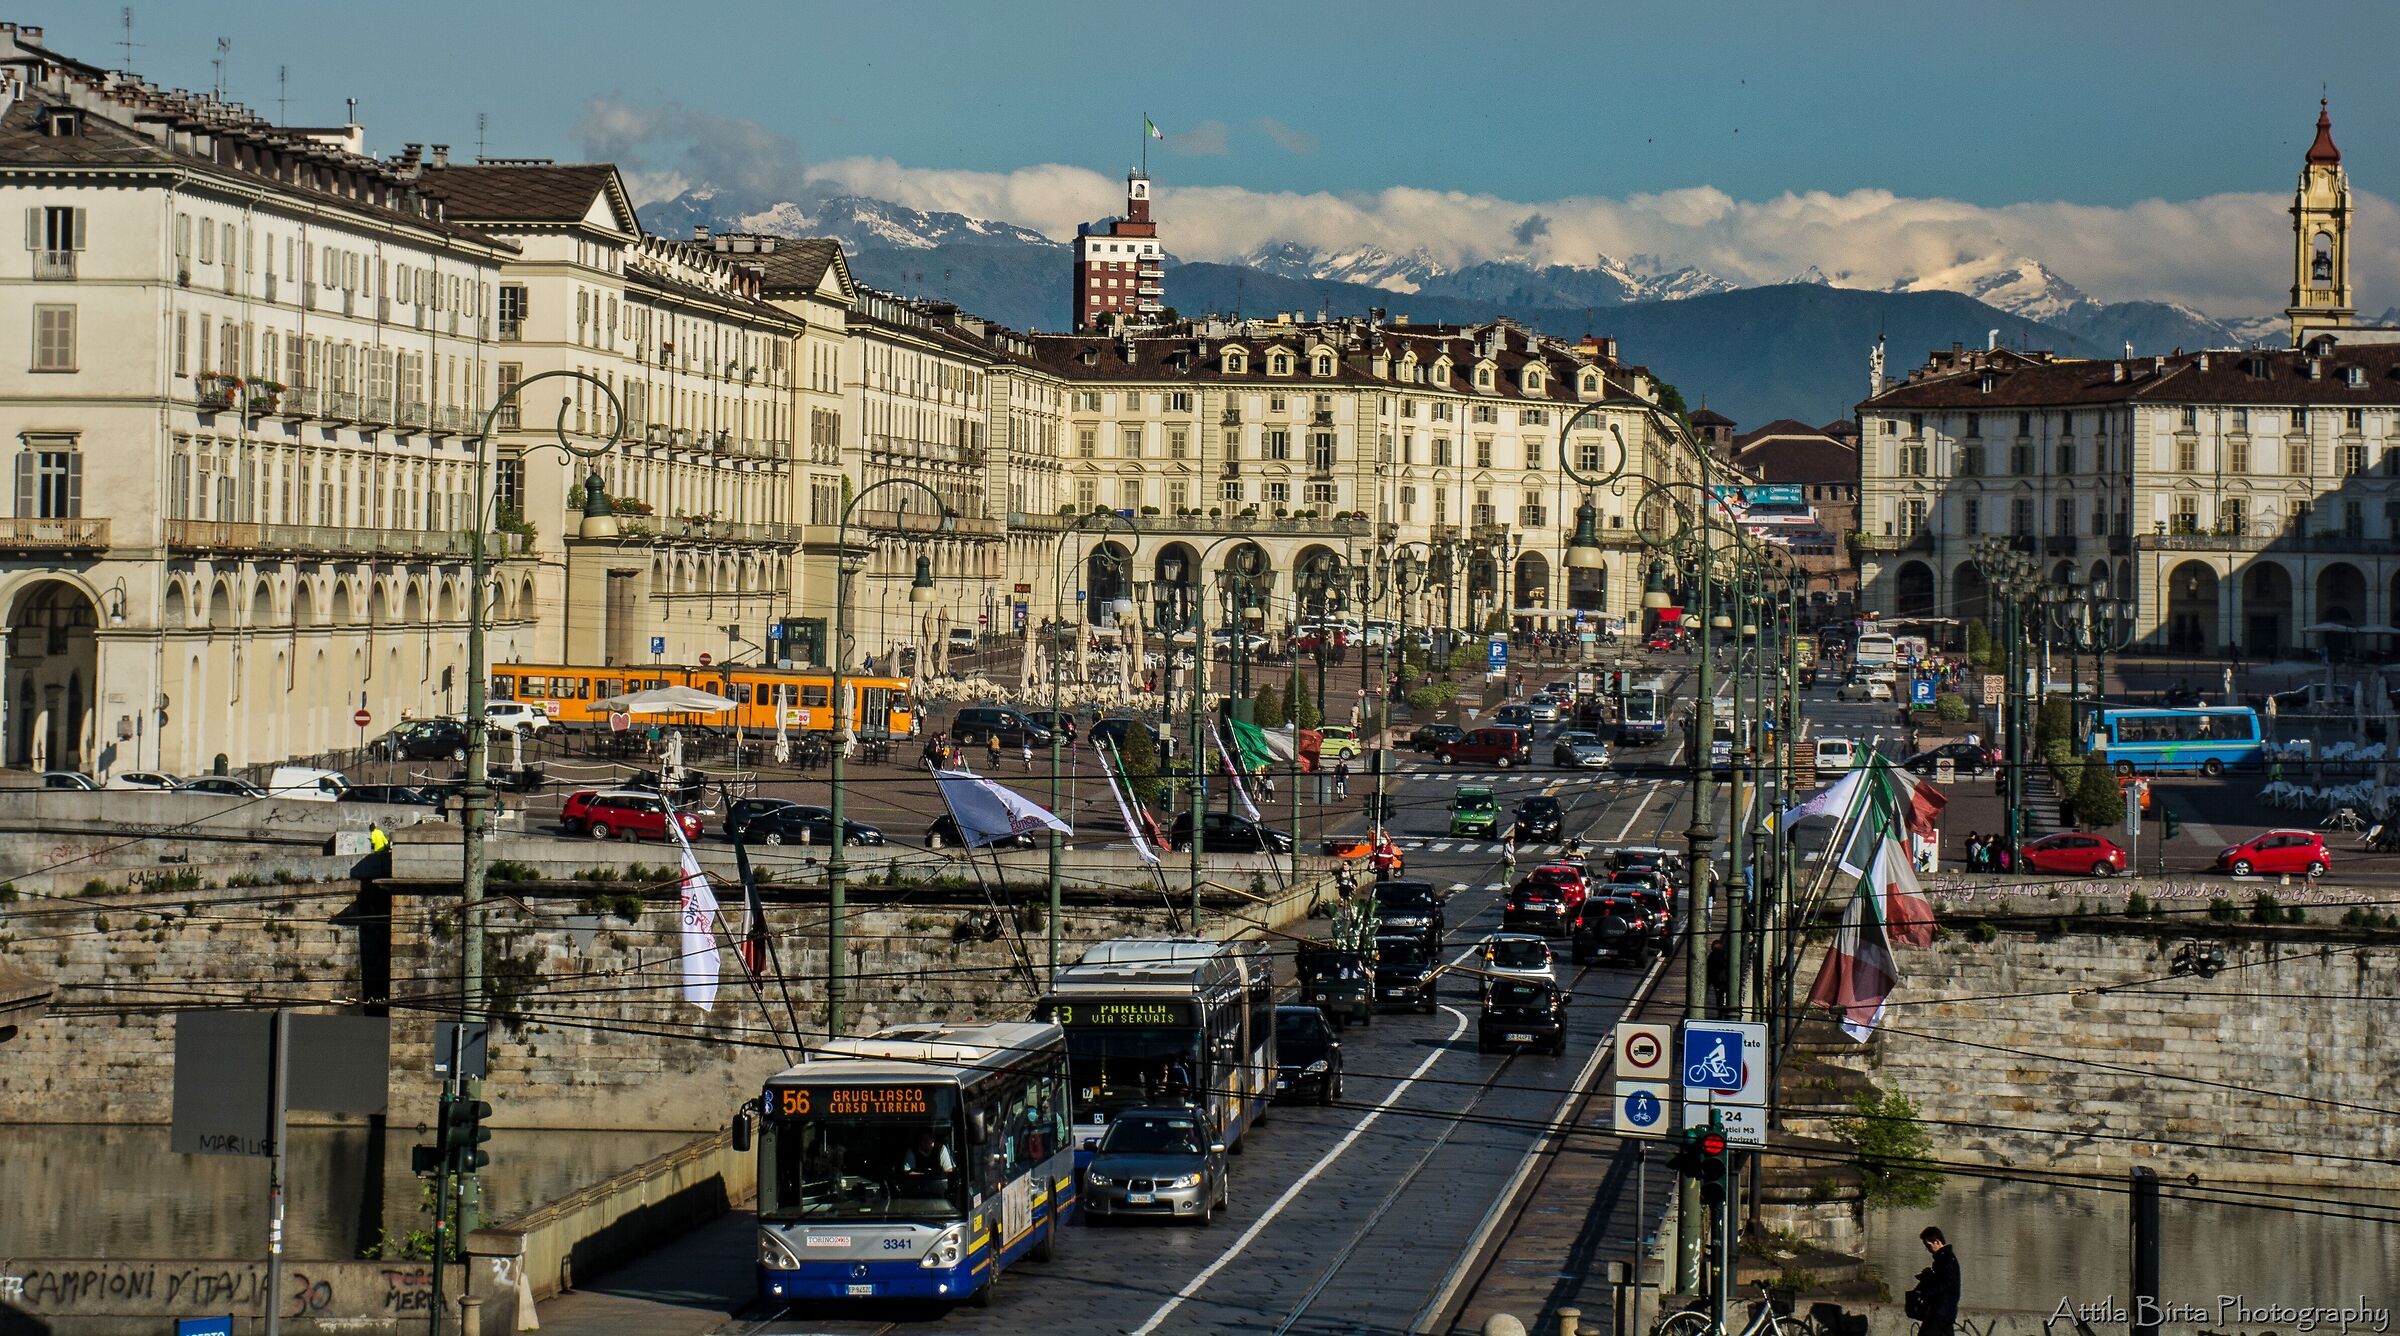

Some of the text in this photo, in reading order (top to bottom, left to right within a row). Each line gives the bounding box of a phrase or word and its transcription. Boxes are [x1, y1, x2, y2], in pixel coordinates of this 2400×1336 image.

[1101, 1005, 1167, 1014] PARELLA
[1091, 1013, 1175, 1024] VIA SERVAIS
[1744, 1040, 1761, 1048] tato
[783, 1089, 923, 1115] 56 GRUGLIASCO
[830, 1101, 926, 1114] CORSO TIRRENO
[1743, 1127, 1756, 1135] M3
[883, 1239, 913, 1250] 3341
